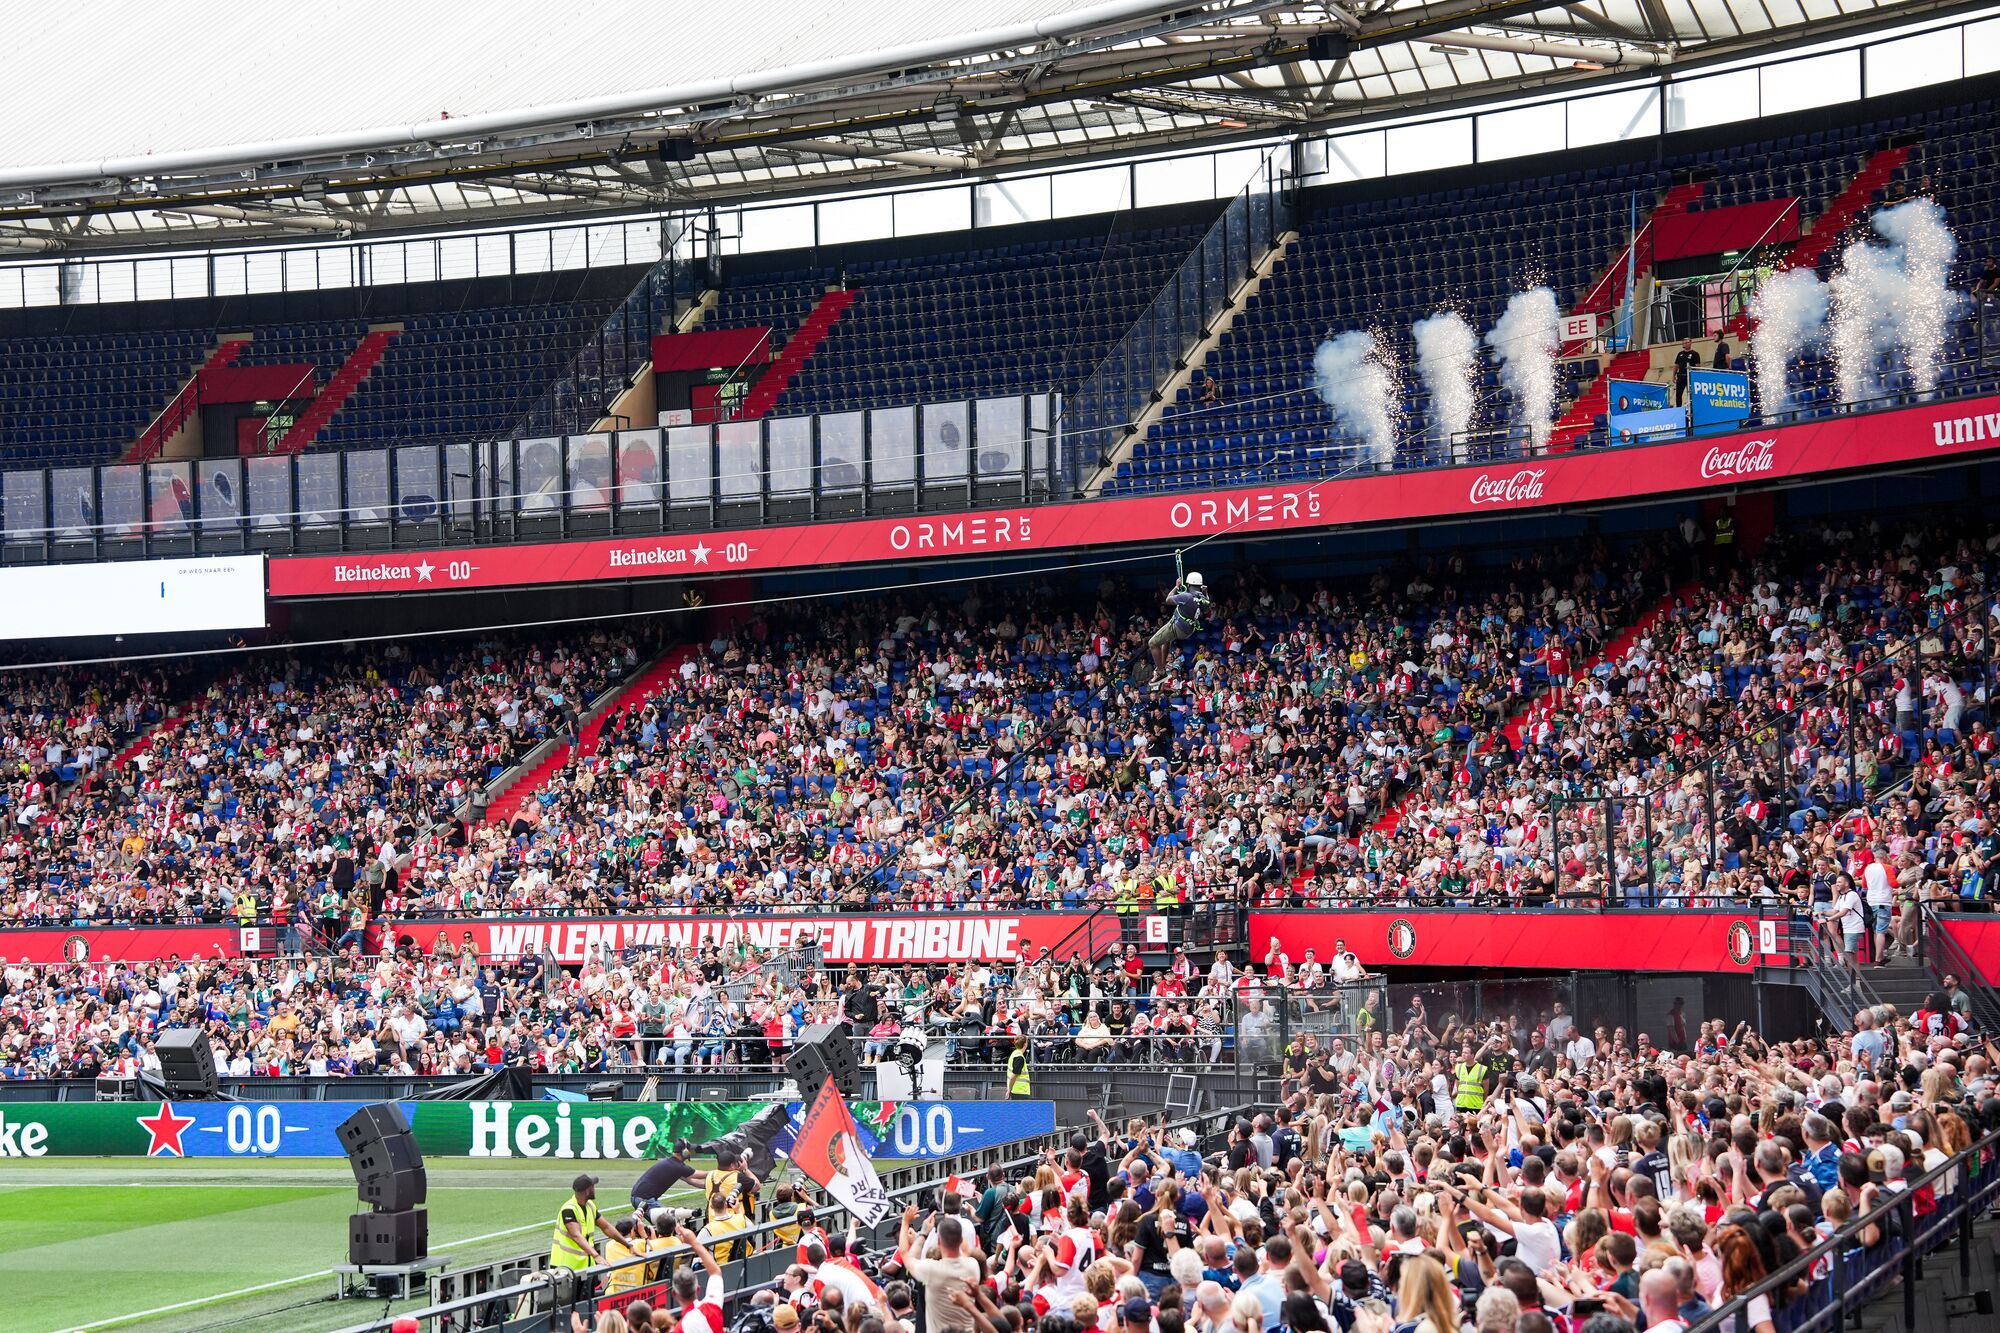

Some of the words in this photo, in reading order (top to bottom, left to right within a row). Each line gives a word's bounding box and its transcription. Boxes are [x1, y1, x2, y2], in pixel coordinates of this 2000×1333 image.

[1567, 319, 1588, 335] EE
[1701, 438, 1776, 478] Coca-Cola
[1469, 468, 1547, 504] Coca-Cola
[1171, 493, 1300, 528] ORMER
[1308, 491, 1320, 518] ICT
[890, 517, 1012, 550] ORMER
[1019, 516, 1031, 541] ICT
[609, 547, 687, 566] Heineken
[334, 564, 411, 582] Heineken
[246, 932, 254, 946] F
[488, 924, 617, 961] WILLEM
[622, 922, 693, 957] VAN
[872, 919, 1019, 959] TRIBUNE
[1152, 922, 1162, 937] E
[1764, 928, 1771, 947] D
[227, 1104, 281, 1153] 0.0
[469, 1102, 670, 1158] Heine
[895, 1104, 953, 1155] 0.0
[1655, 1169, 1672, 1201] 19
[1078, 1248, 1092, 1272] 4
